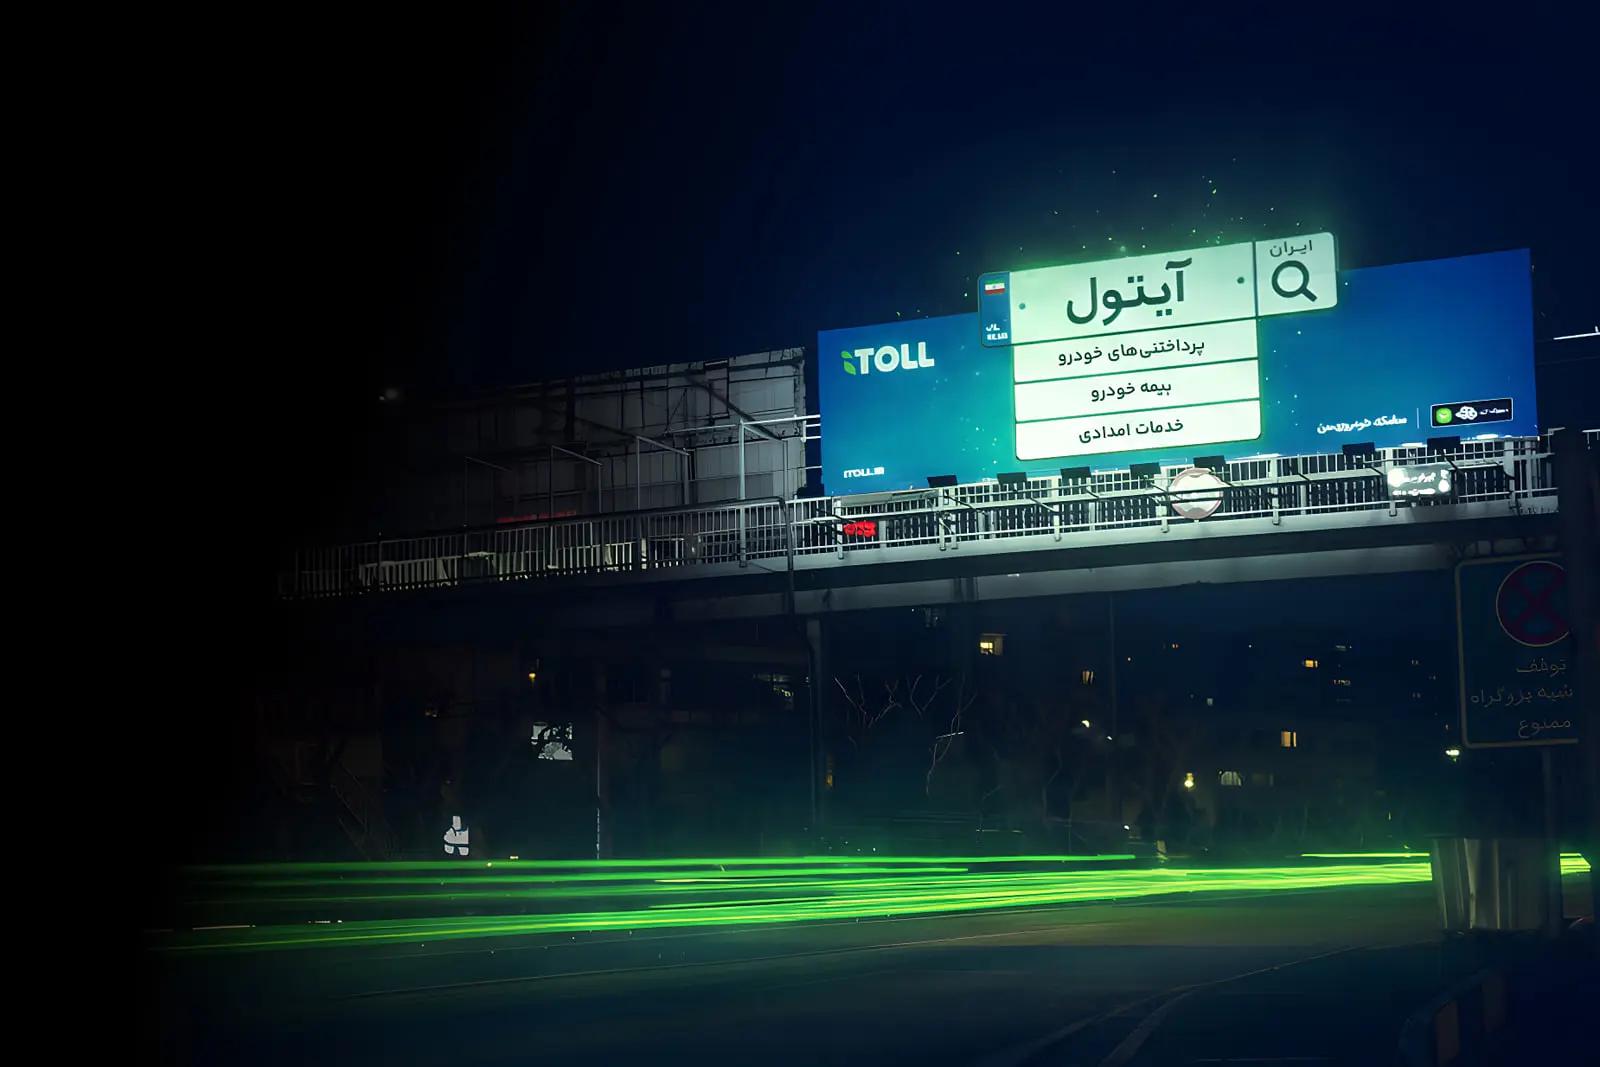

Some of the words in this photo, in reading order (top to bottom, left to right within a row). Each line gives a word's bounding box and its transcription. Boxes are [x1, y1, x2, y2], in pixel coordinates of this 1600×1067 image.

[1269, 239, 1313, 258] ایران
[1066, 257, 1192, 325] آیتول
[1058, 346, 1103, 366] خودرو
[1091, 382, 1135, 402] خودرو
[1140, 382, 1172, 399] بیمه
[1079, 423, 1131, 444] امدادی
[1135, 417, 1184, 437] خدمات
[1515, 656, 1569, 678] توقف
[1517, 718, 1571, 739] ممنوع
